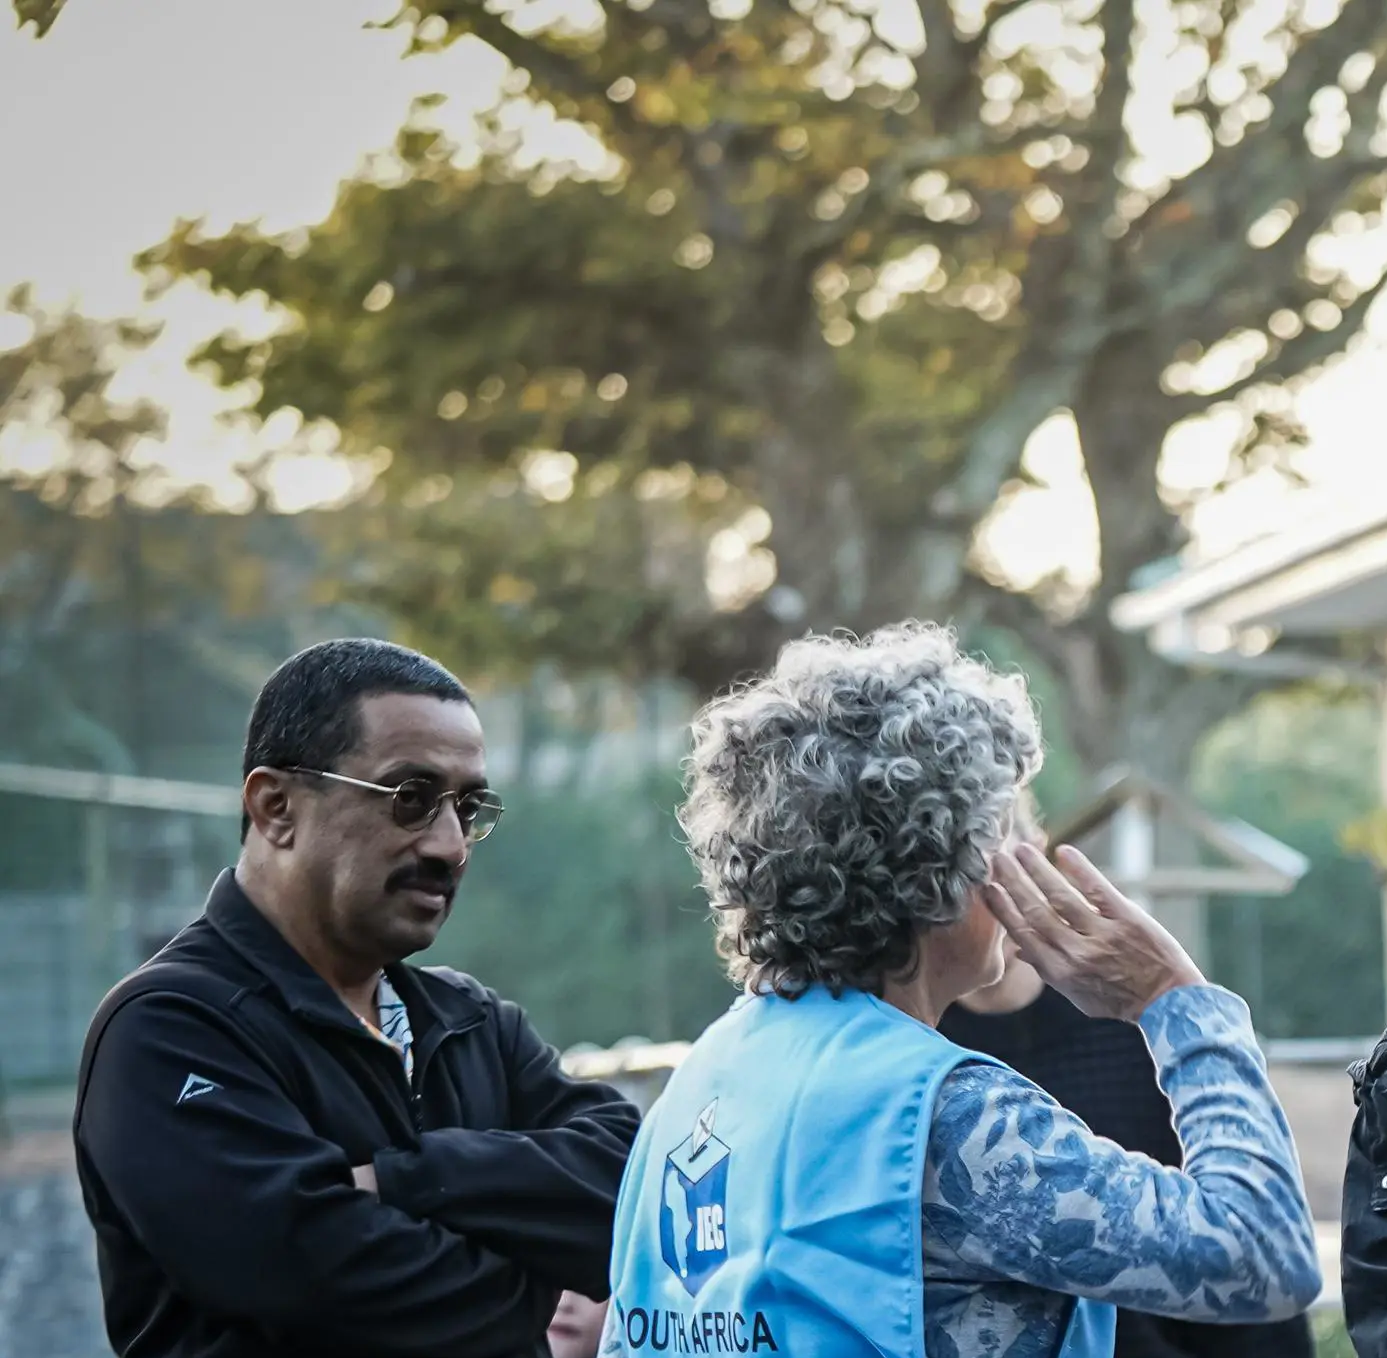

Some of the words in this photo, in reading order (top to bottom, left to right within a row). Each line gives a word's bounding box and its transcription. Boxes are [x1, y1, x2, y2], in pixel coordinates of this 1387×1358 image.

[697, 1204, 725, 1251] IEC
[617, 1302, 690, 1353] OUTH
[691, 1311, 778, 1353] AFRICA
